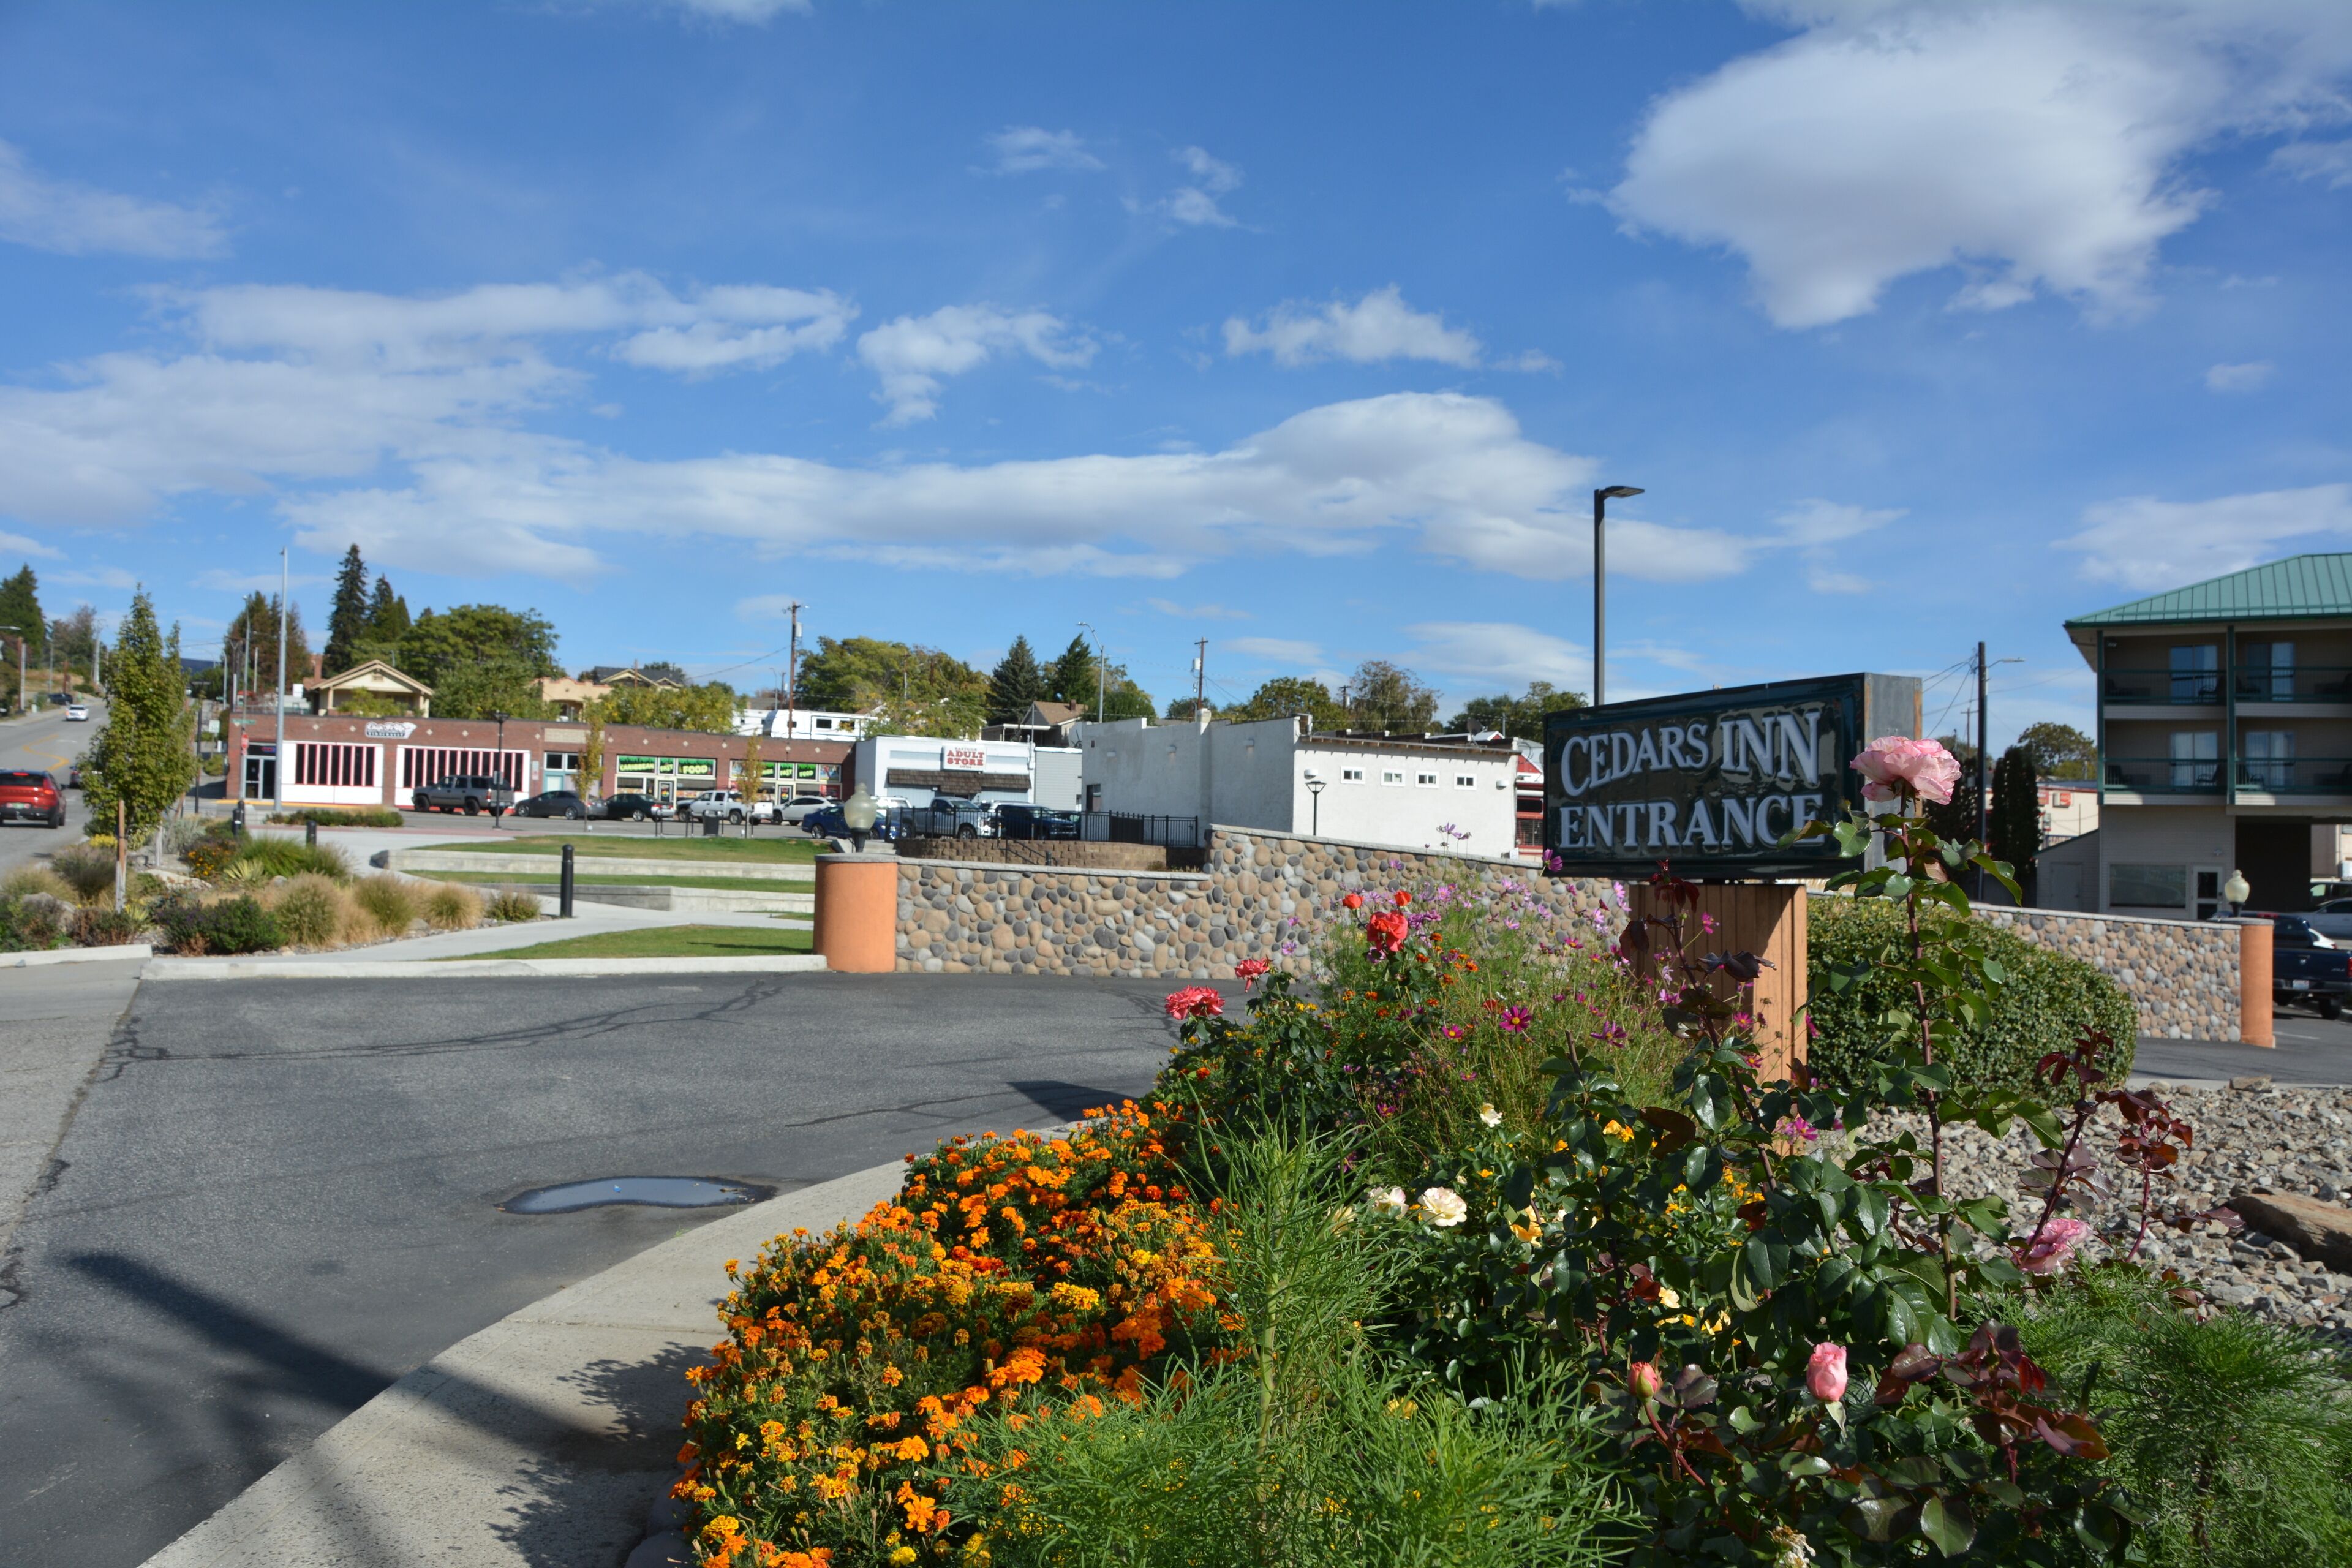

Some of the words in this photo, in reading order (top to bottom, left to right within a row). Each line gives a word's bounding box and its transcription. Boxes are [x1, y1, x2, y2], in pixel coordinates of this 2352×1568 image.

[947, 750, 984, 758] ADULT
[1561, 723, 1709, 796] CEDARS
[1720, 711, 1821, 785] INN
[660, 764, 673, 772] FAST
[682, 764, 709, 774] FOOD
[799, 769, 814, 778] FOOD
[1560, 794, 1825, 848] ENTRANCE
